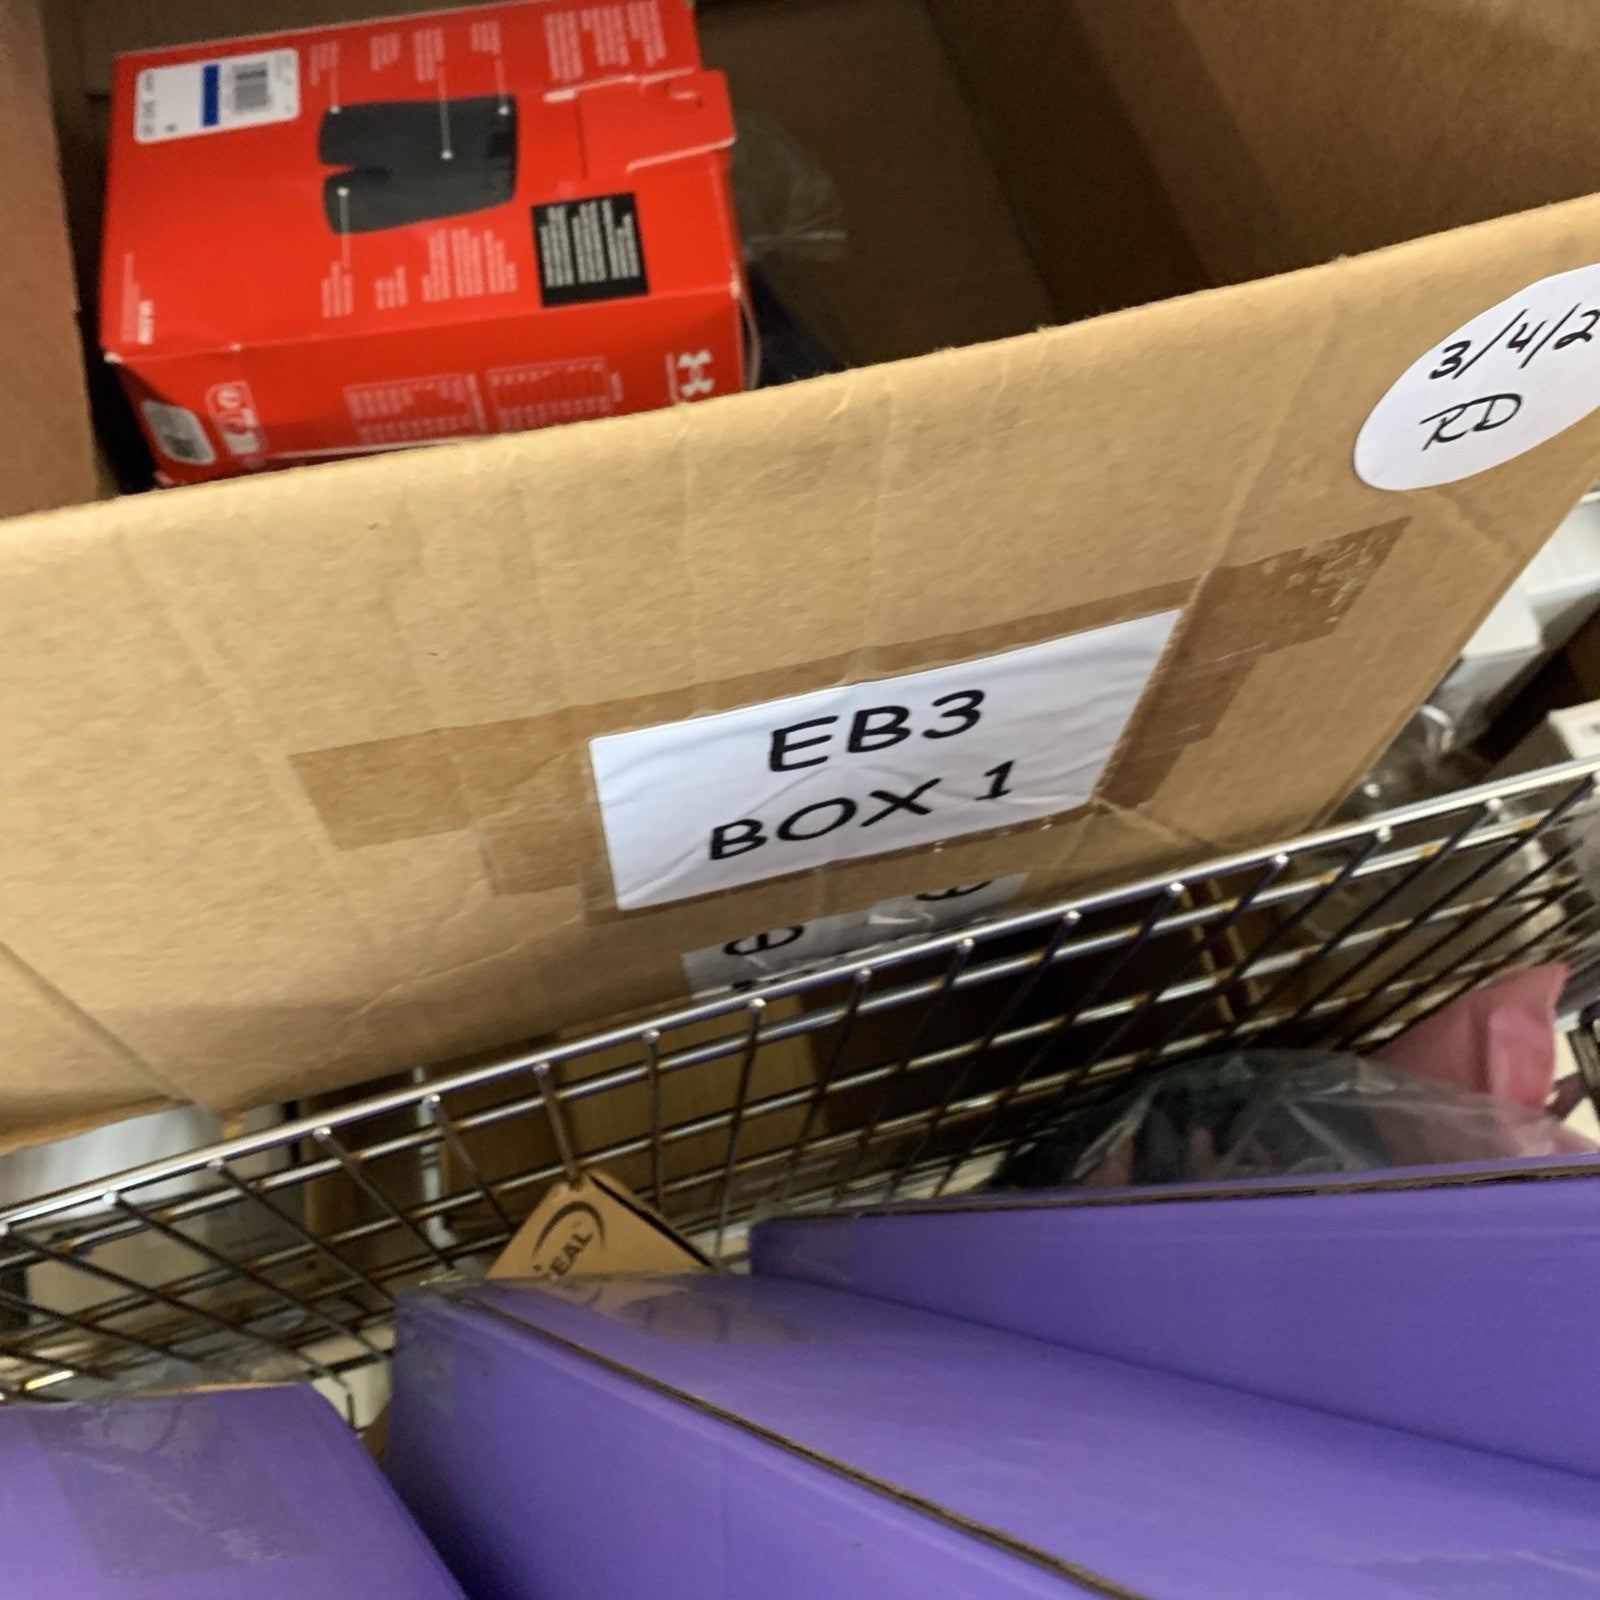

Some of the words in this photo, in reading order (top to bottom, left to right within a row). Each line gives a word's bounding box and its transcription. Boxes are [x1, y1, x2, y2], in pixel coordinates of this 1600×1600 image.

[769, 688, 986, 773] EB3
[709, 777, 942, 862] BOX
[975, 760, 1015, 801] 1
